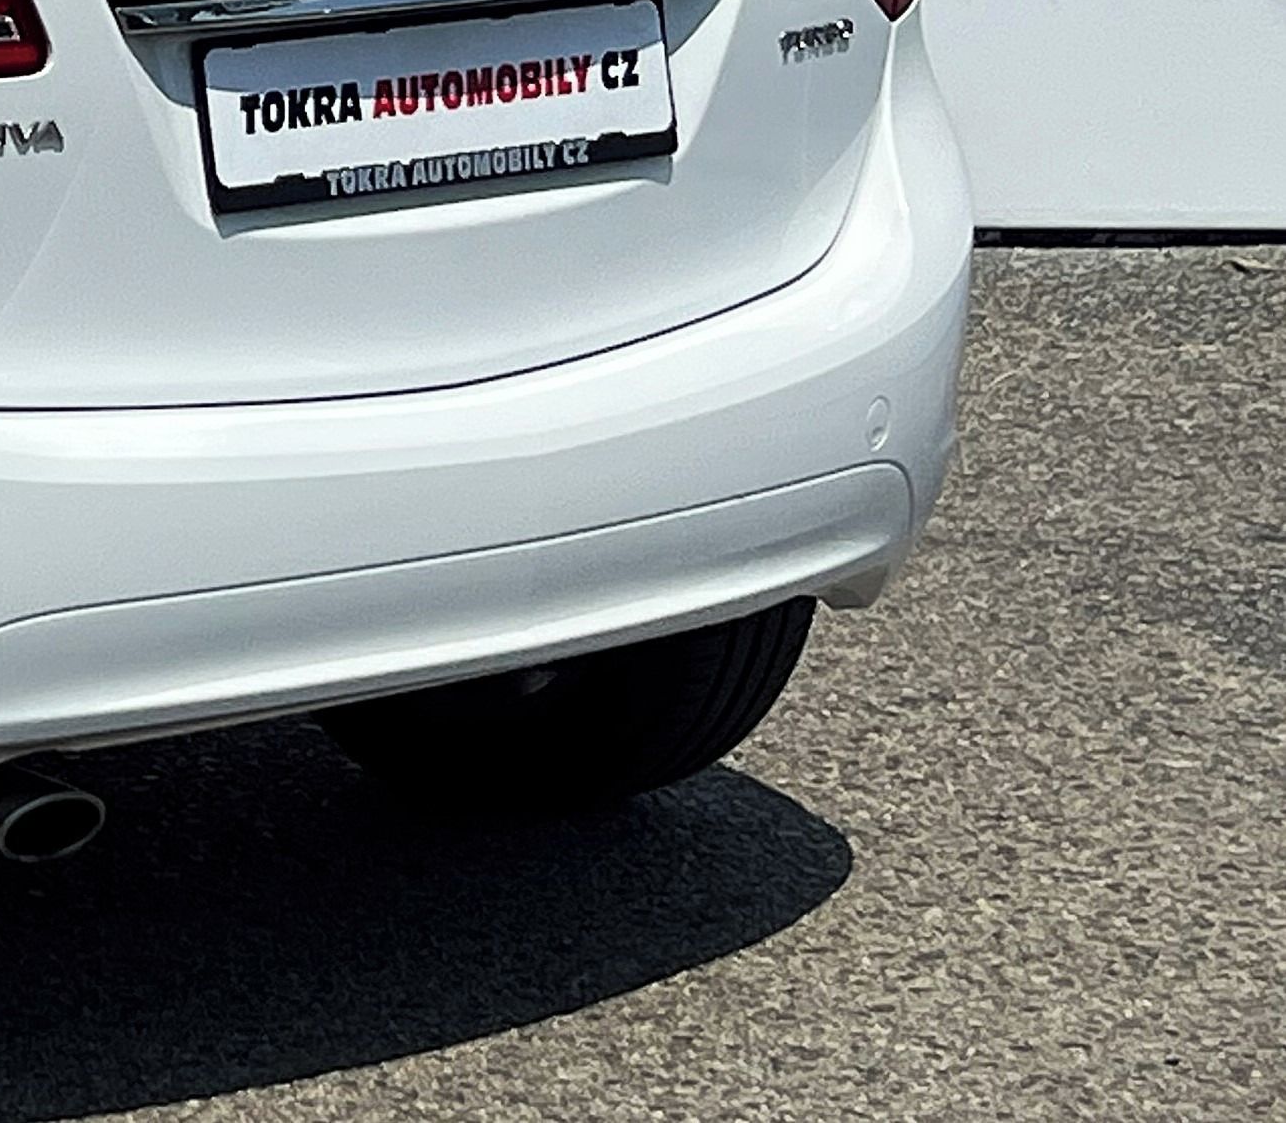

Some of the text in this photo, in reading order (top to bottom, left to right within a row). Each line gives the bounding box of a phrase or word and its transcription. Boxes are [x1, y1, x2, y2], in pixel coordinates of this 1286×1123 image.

[240, 49, 640, 134] TOKRA AUTOMOBILY CZ
[326, 140, 590, 196] TOKRA AUTOMOBILY CZ
